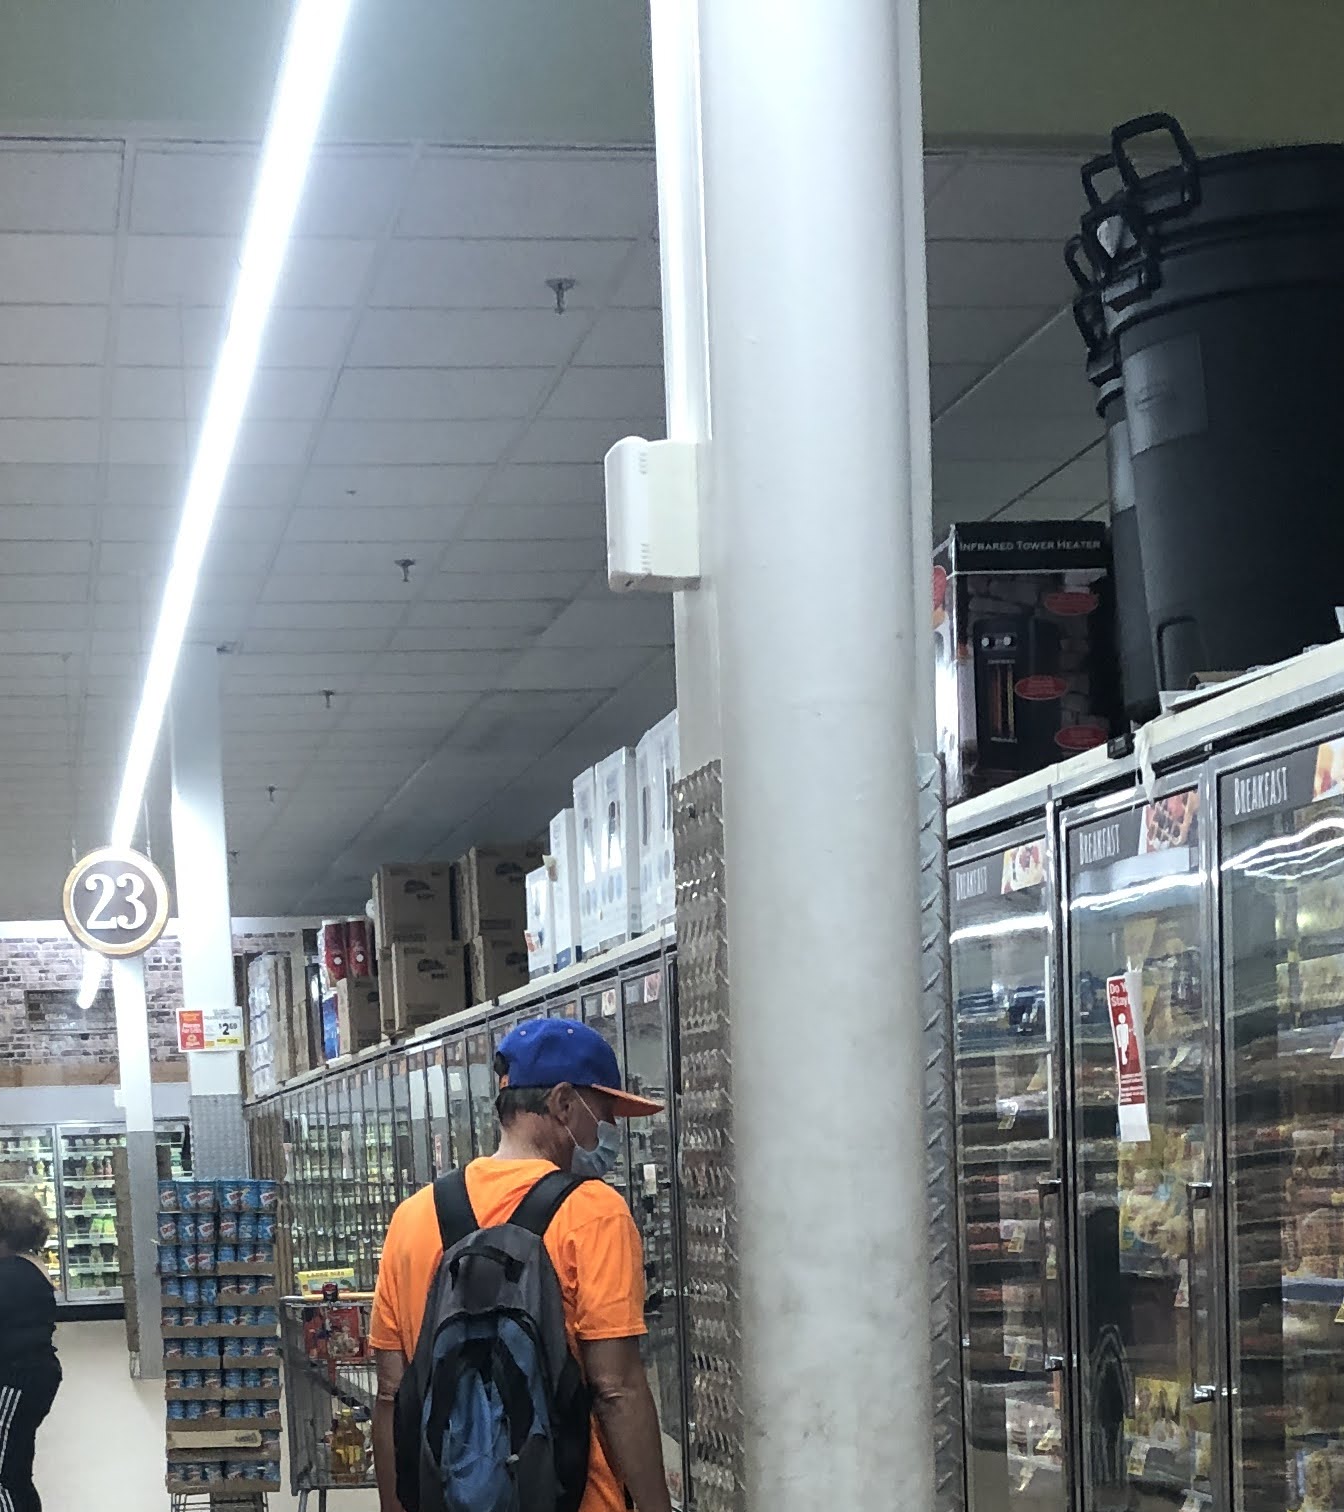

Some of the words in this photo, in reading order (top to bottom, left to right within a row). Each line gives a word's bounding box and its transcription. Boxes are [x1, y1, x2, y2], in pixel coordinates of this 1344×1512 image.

[1016, 540, 1054, 550] TOWER
[1056, 540, 1101, 549] HEATER
[1234, 766, 1288, 815] BREAKFAST
[1079, 823, 1121, 865] BREAKFAST
[84, 872, 148, 930] 23
